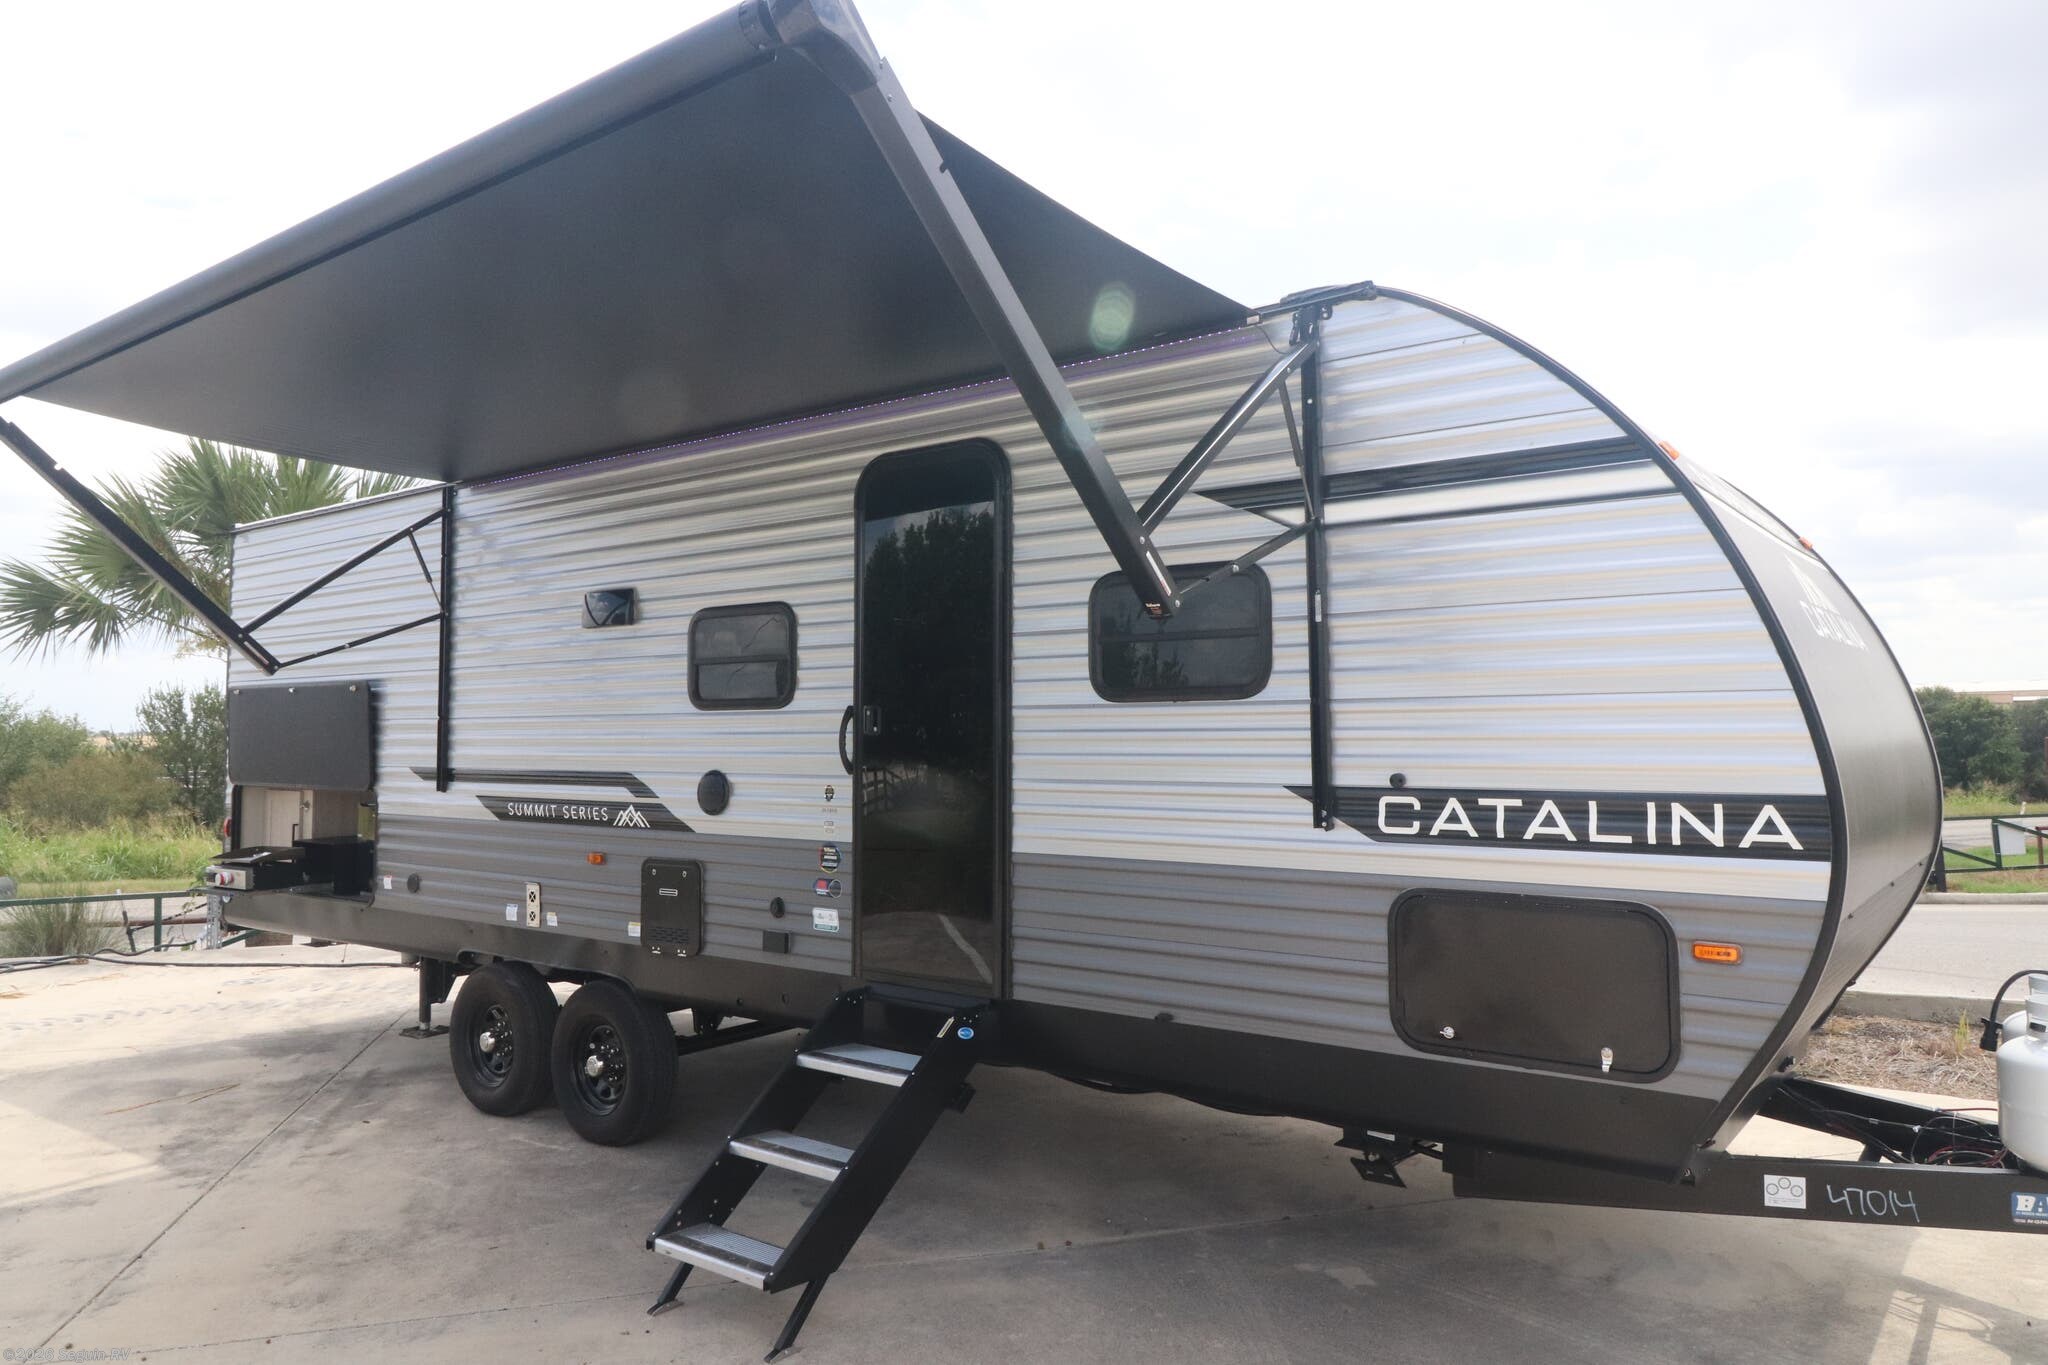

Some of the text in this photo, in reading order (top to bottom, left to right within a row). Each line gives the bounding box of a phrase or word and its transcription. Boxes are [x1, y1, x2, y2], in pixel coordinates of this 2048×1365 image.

[507, 802, 608, 821] SUMMIT SERIES
[1378, 795, 1804, 850] CATALINA
[1826, 1184, 1920, 1223] 47014
